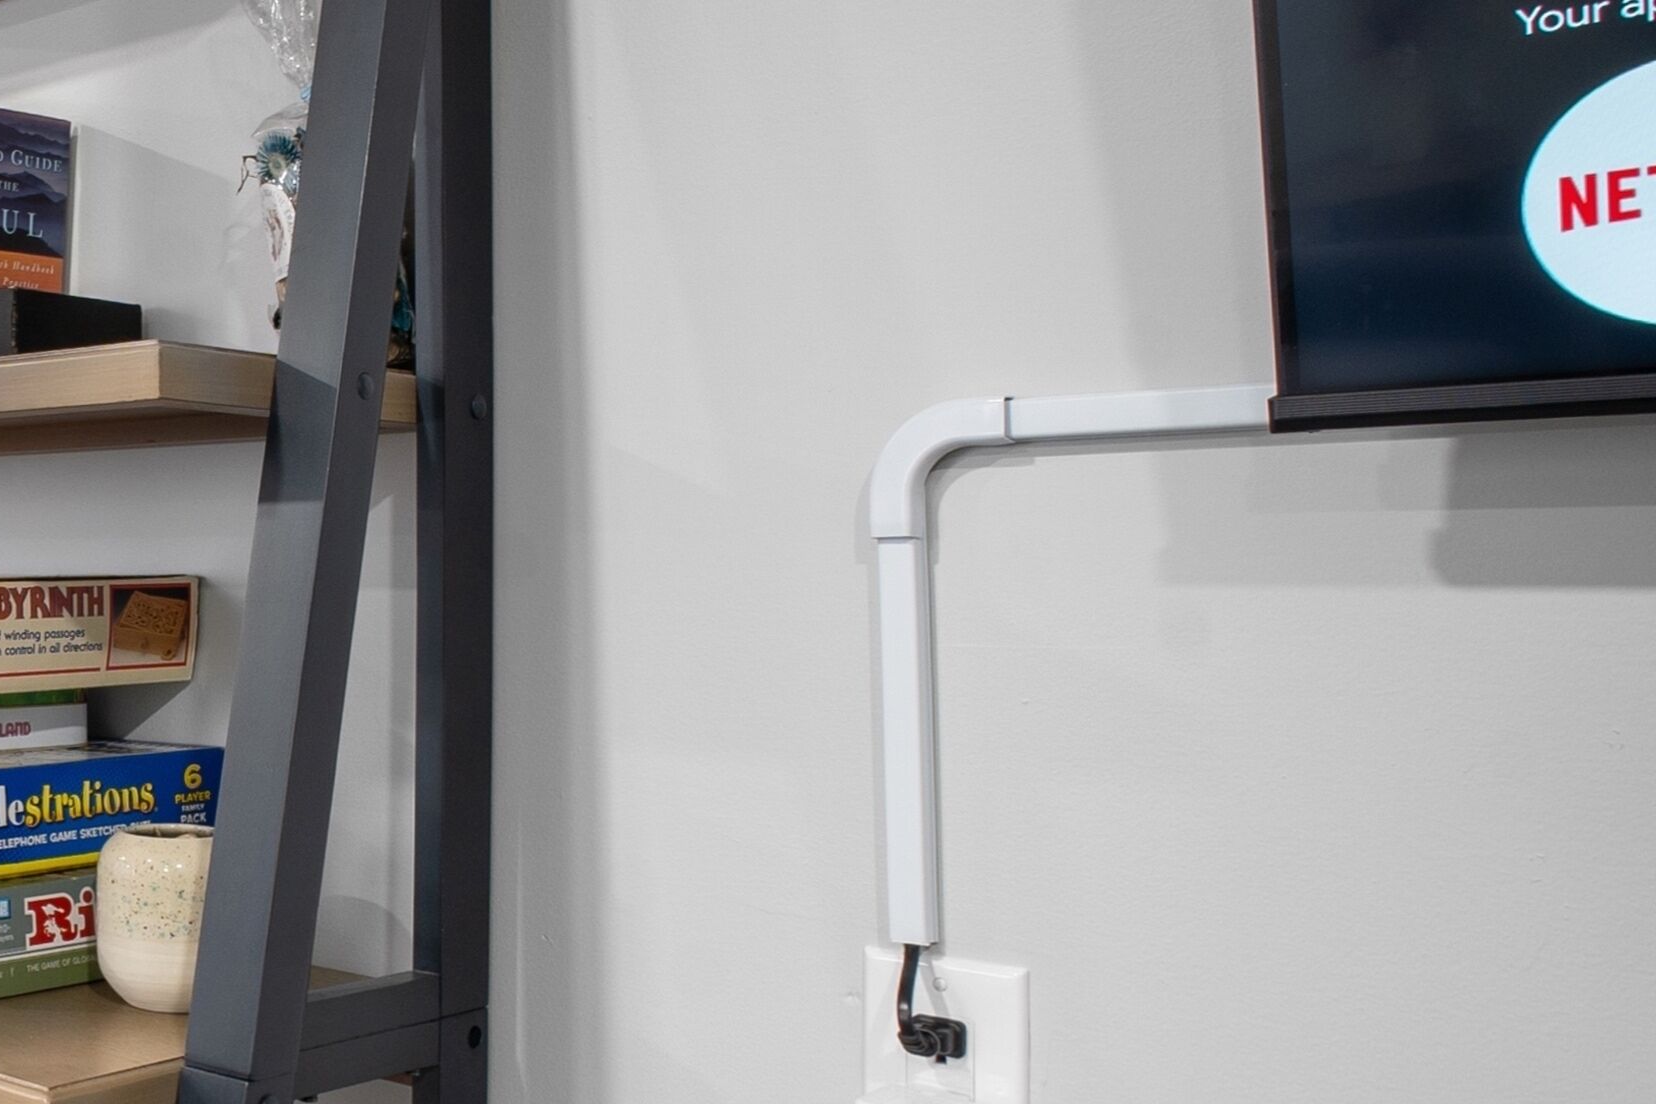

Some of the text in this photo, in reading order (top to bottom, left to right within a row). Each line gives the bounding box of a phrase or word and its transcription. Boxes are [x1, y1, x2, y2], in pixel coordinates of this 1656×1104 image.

[1515, 1, 1610, 36] Your
[11, 149, 63, 173] GUIDE
[12, 261, 55, 275] Handbook
[4, 629, 41, 644] winding
[44, 629, 86, 644] passages
[5, 645, 35, 657] control
[38, 645, 47, 655] in
[49, 643, 60, 654] all
[63, 641, 103, 654] directions
[183, 763, 202, 789] 6
[174, 790, 211, 806] PLAYER
[180, 802, 206, 813] FAMILY
[180, 812, 207, 824] PACK
[50, 827, 78, 843] GAME
[27, 957, 70, 973] THE GAME OF
